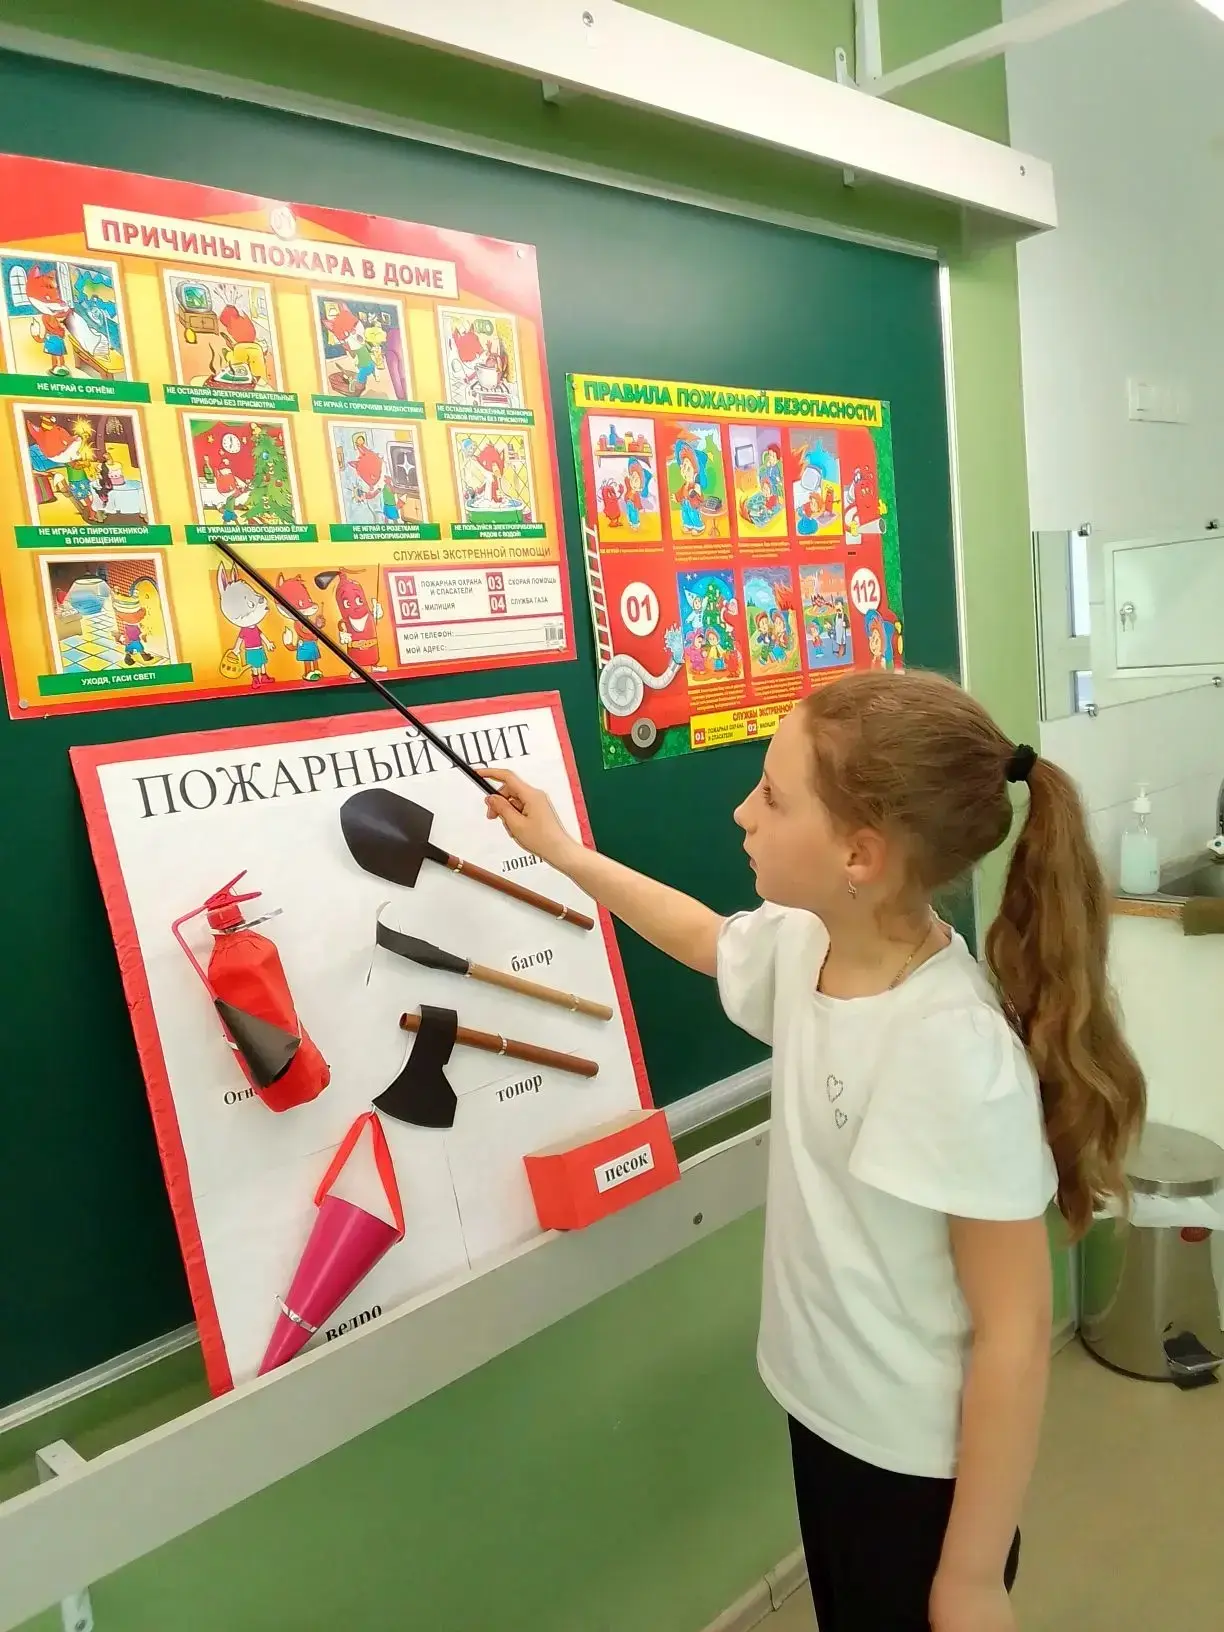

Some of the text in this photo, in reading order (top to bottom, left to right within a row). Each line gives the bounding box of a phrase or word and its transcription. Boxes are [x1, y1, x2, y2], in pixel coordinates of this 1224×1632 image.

[101, 219, 241, 260] ПРИЧИНЫ
[250, 243, 355, 277] ПОЖАРА
[362, 258, 376, 279] В
[383, 261, 444, 289] ДОМЕ
[37, 382, 115, 395] НЕ ИГРАЙ С ОГНЁМ!
[166, 386, 176, 394] НЕ
[177, 387, 211, 396] ОСТАВЛЯЙ
[191, 397, 223, 406] ПРИБОРЫ
[224, 399, 236, 407] БЕЗ
[584, 380, 877, 421] ПРАВИЛА ПОЖАРНОЙ БЕЗОПАСНОСТИ
[39, 526, 148, 535] НЕ ИГРАЙ С ПИРОТЕХНИКОЙ
[197, 526, 206, 534] НЕ
[207, 525, 240, 533] УКРАШАЙ
[74, 536, 126, 545] ПОМЕЩЕНИИ!
[393, 546, 551, 562] СЛУЖБЫ ЭКСТРЕННОЙ ПОМОЩИ
[397, 578, 482, 595] 01 ПОЖАРНАЯ ОХРАНА
[488, 575, 556, 590] 03 СКОРАЯ ПОМОЩЬ
[437, 587, 473, 595] СПАСАТЕЛИ
[851, 578, 878, 604] 112
[401, 602, 455, 618] 02 МИЛИЦИЯ
[490, 597, 506, 612] 04
[510, 597, 533, 605] СЛУЖБА
[625, 593, 652, 622] 01
[404, 630, 454, 640] МОЙ ТЕЛЕФОН:
[406, 644, 447, 655] МОЙ АДРЕС:
[81, 672, 156, 686] УХОДЯ, ГАСИ СВЕТ!
[132, 723, 531, 818] ПОЖАРНЫЙ ЩИТ
[511, 948, 554, 973] багор
[495, 1073, 543, 1102] топор
[604, 1152, 649, 1182] песок
